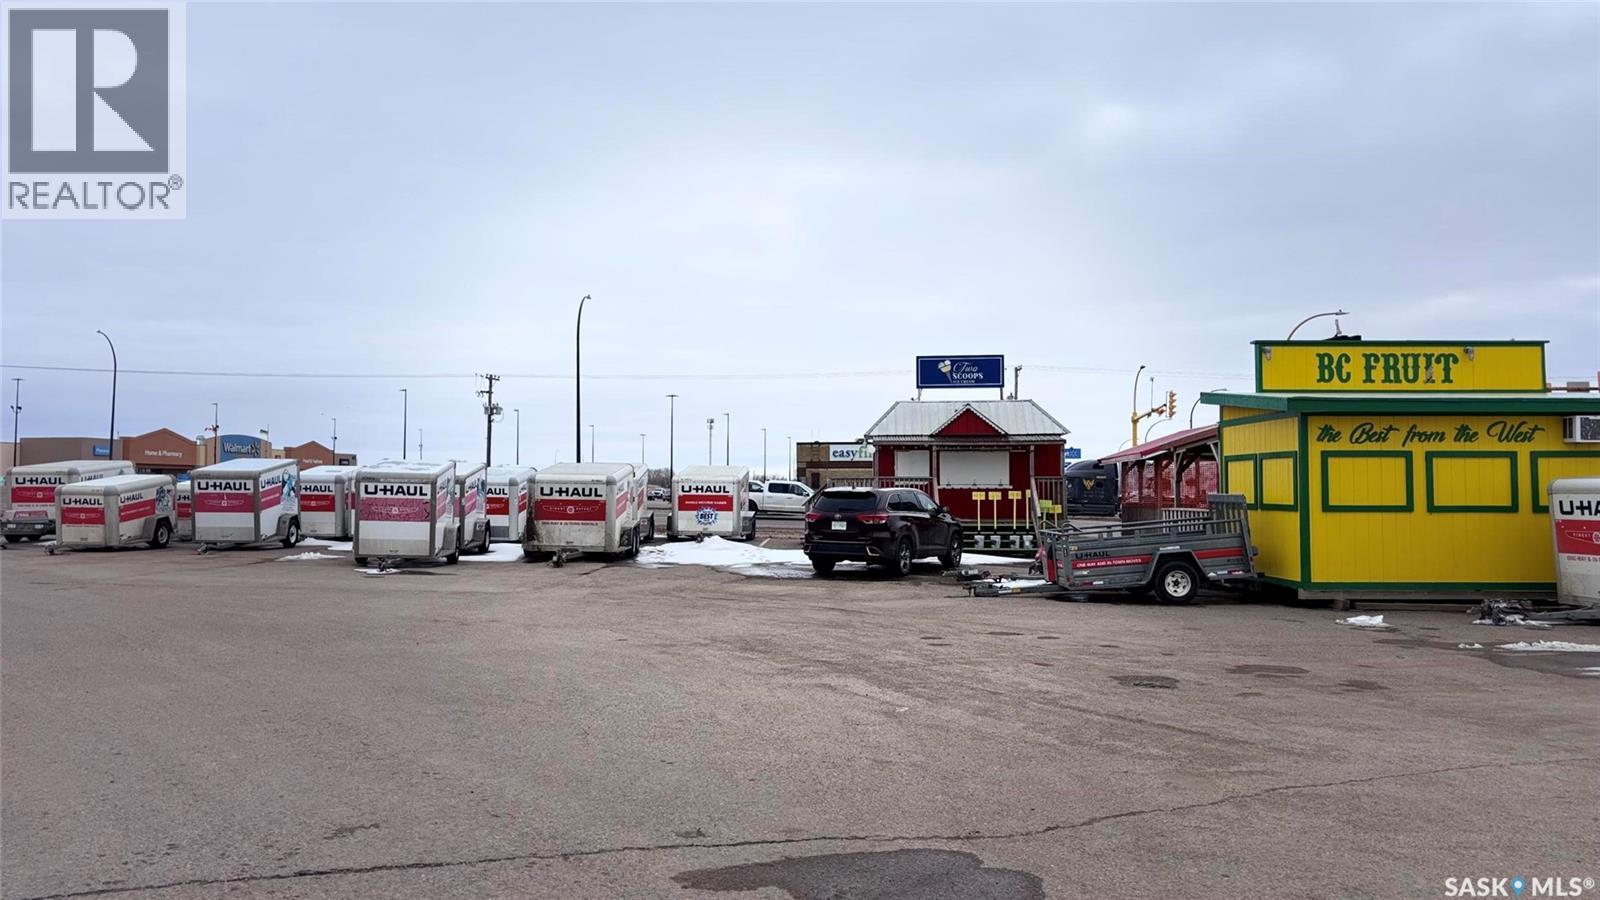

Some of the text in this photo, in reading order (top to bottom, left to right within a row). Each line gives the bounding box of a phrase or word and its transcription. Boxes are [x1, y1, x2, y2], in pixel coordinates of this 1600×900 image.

[953, 362, 978, 374] Two
[1316, 352, 1460, 384] BC FRUIT
[952, 372, 984, 380] SCOOPS
[1316, 420, 1545, 447] the Best from the West
[223, 441, 252, 455] Walmart
[15, 477, 65, 485] U-HAUL
[197, 481, 251, 491] U-HAUL
[364, 484, 428, 496] U-HAUL
[540, 487, 603, 497] U-HAUL
[681, 485, 730, 493] U-HAUL
[63, 498, 103, 506] U-HAUL
[700, 512, 714, 520] BEST
[1075, 551, 1109, 560] U-HAUL
